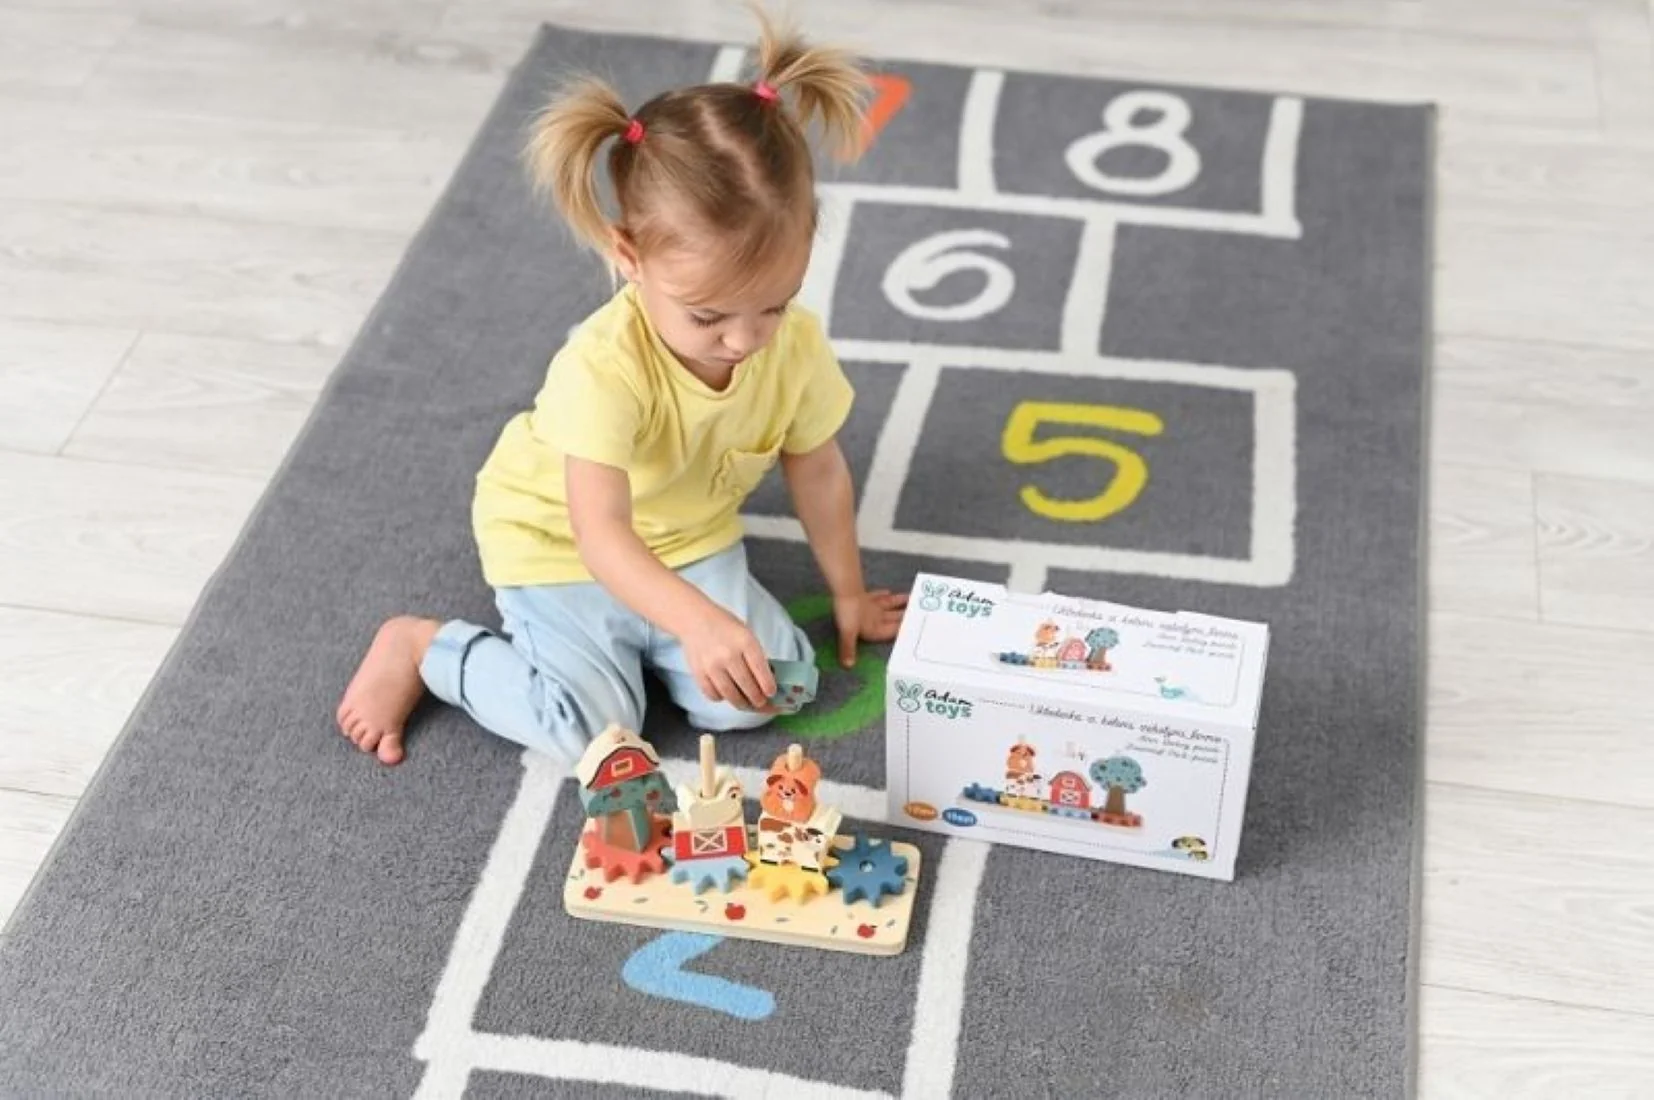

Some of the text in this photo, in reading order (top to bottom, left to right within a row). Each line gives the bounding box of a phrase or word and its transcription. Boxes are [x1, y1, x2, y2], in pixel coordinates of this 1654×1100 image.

[1065, 90, 1201, 196] 8
[881, 229, 1015, 321] 6
[1002, 400, 1164, 522] 5
[947, 600, 993, 618] toys
[924, 689, 974, 706] Adam
[925, 700, 972, 719] toys
